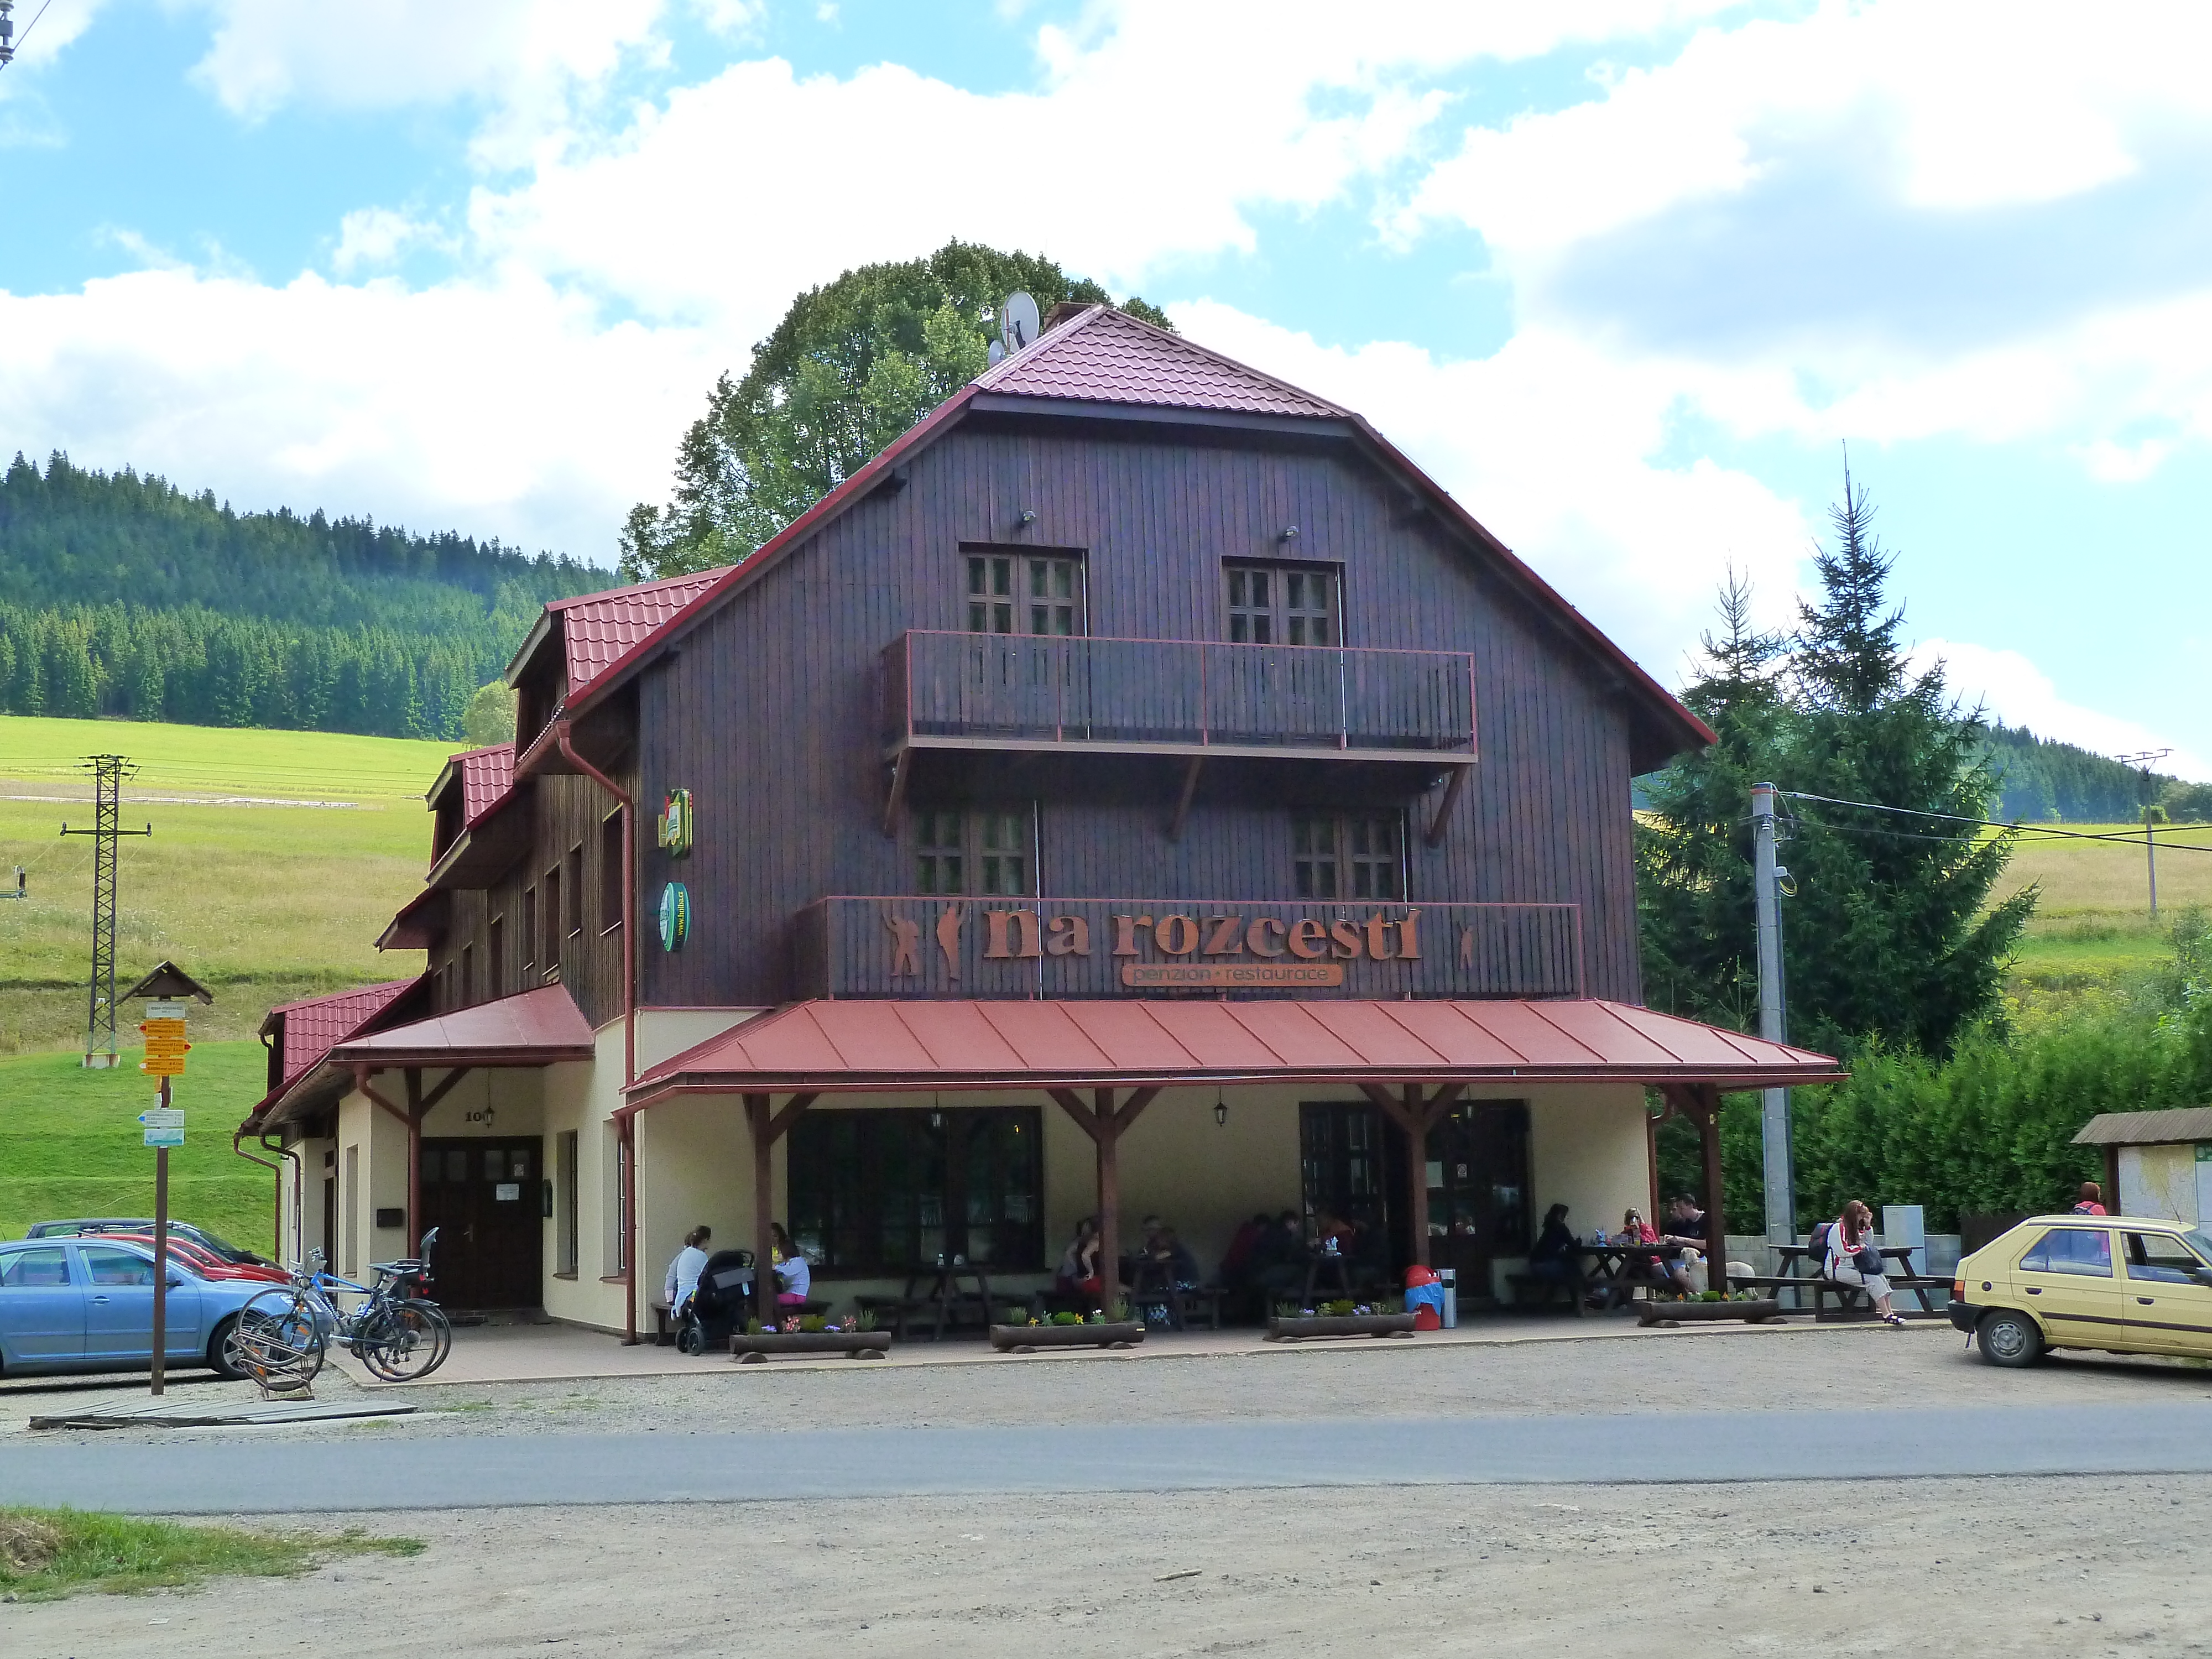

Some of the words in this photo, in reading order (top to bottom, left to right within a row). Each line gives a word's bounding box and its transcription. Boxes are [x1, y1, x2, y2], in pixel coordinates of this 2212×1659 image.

[983, 909, 1093, 958] na
[1112, 909, 1422, 960] rozcestí
[1133, 966, 1212, 984] penzion
[1226, 966, 1328, 981] restaurace
